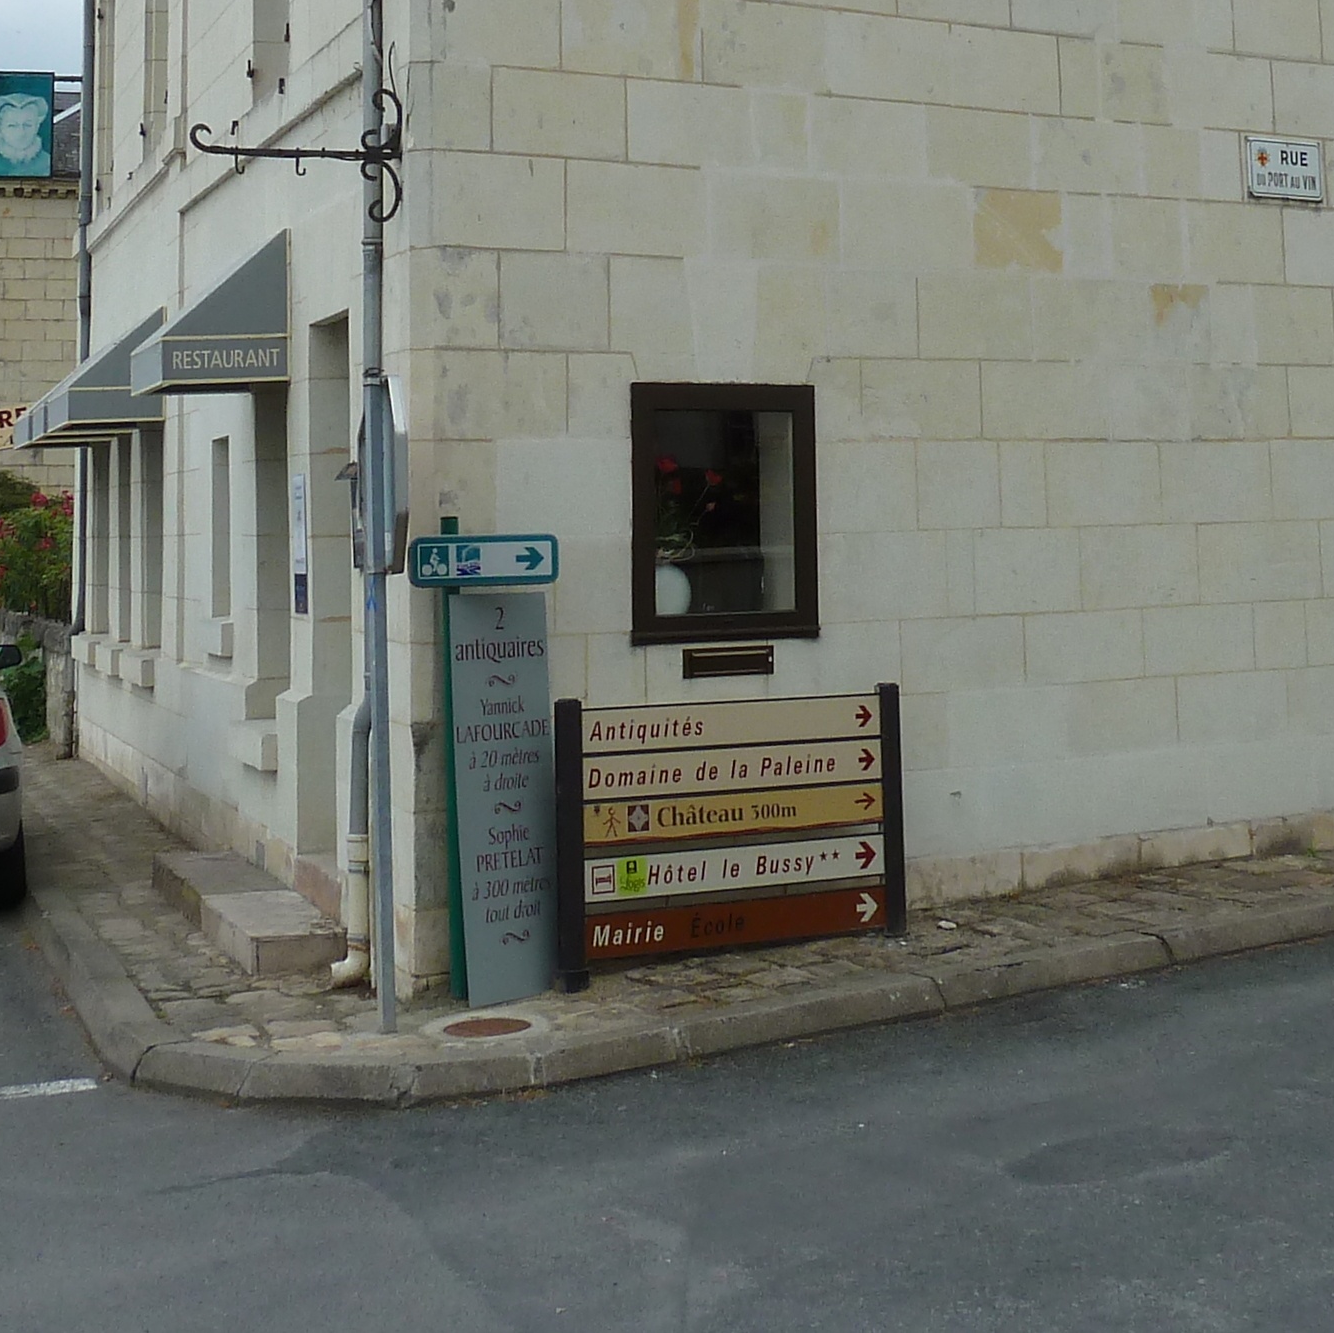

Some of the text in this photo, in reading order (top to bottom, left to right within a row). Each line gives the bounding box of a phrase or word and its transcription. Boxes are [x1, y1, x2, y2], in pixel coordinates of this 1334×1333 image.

[1280, 150, 1308, 166] RUE
[1267, 171, 1289, 187] PORT
[1290, 176, 1301, 189] AU
[1302, 175, 1317, 191] VIN
[172, 348, 280, 370] RESTAURANT
[495, 606, 505, 631] 2
[455, 636, 545, 664] antiquaires
[480, 695, 525, 717] Yannick
[456, 718, 550, 744] LAFOURCADE
[589, 716, 704, 745] Antiquités
[469, 747, 540, 770] à 20 mètres
[483, 772, 529, 792] à droite
[588, 754, 836, 789] Domaine de la Paleine
[656, 802, 744, 828] Château
[488, 823, 530, 850] Sophie
[476, 846, 545, 873] PRETELAT
[647, 854, 814, 886] Hôtel le Bussy
[472, 881, 480, 901] à
[483, 878, 509, 900] 300
[486, 899, 541, 923] tout droit
[592, 912, 746, 947] Mairie École
